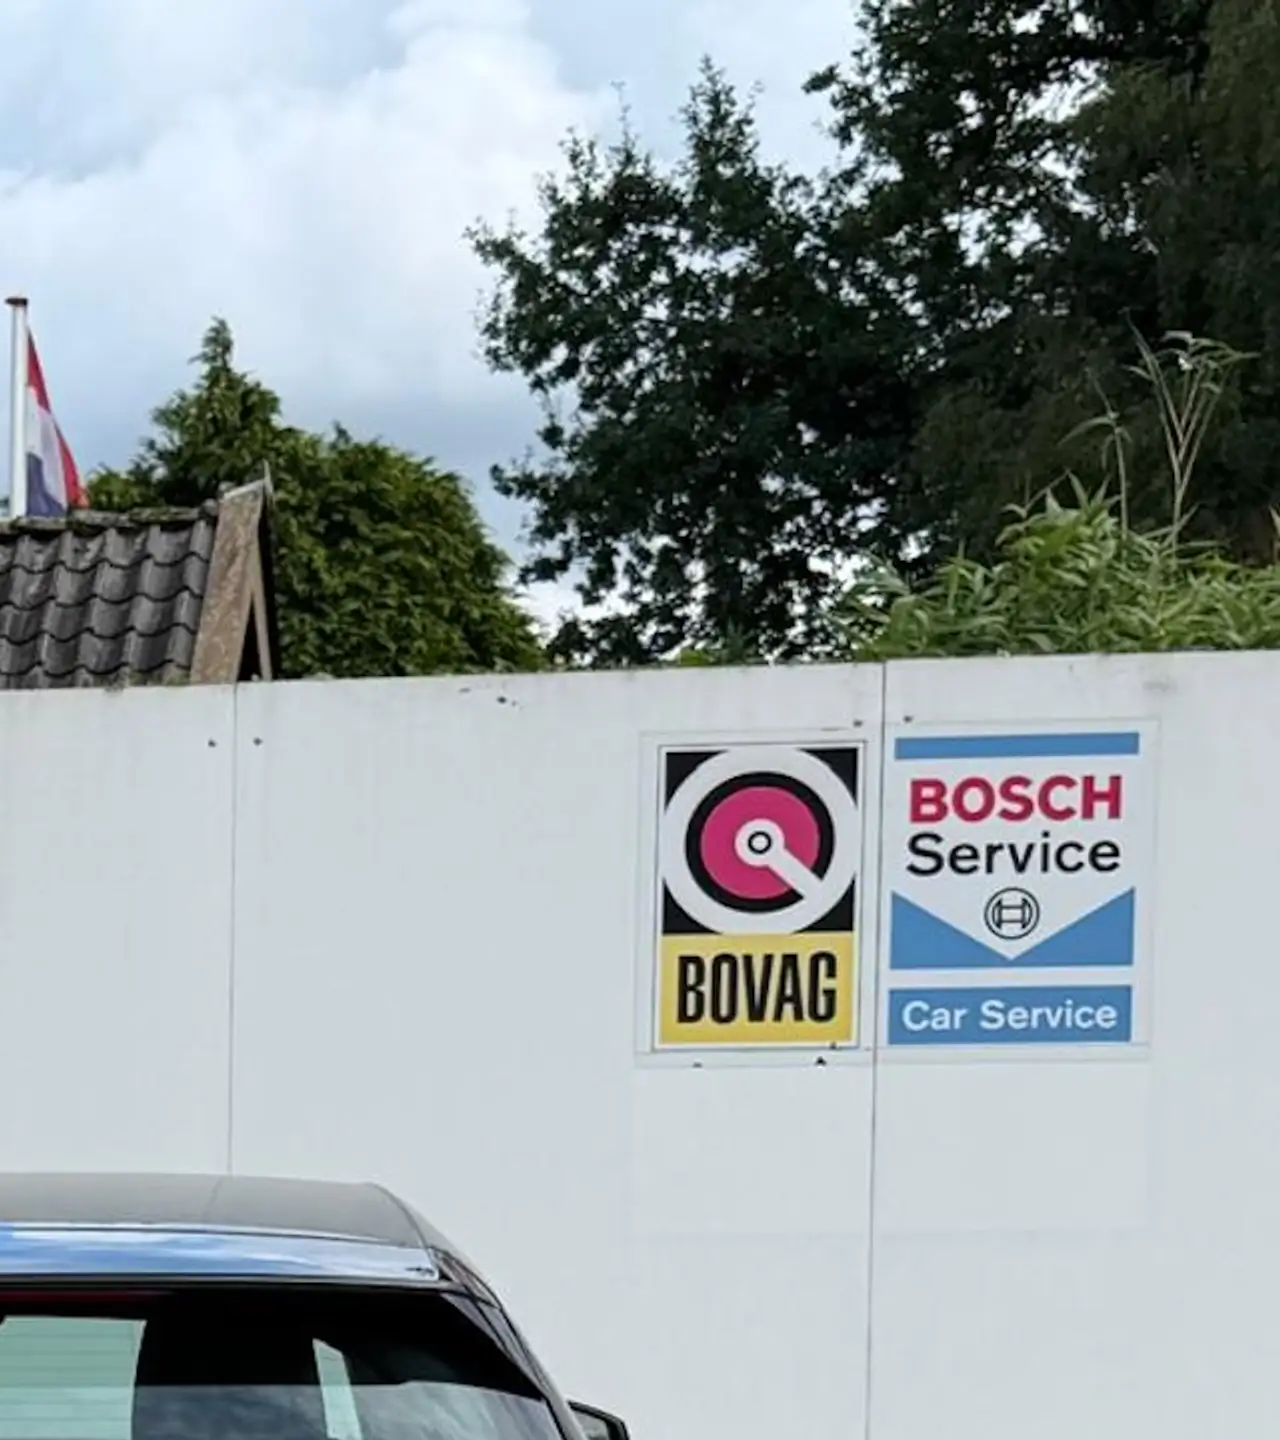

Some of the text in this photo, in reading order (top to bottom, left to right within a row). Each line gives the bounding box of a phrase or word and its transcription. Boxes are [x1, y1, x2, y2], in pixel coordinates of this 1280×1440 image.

[910, 775, 1122, 823] BOSCH
[906, 832, 1120, 877] Service
[677, 952, 838, 1025] BOVAG
[902, 1000, 1118, 1031] Car Service
